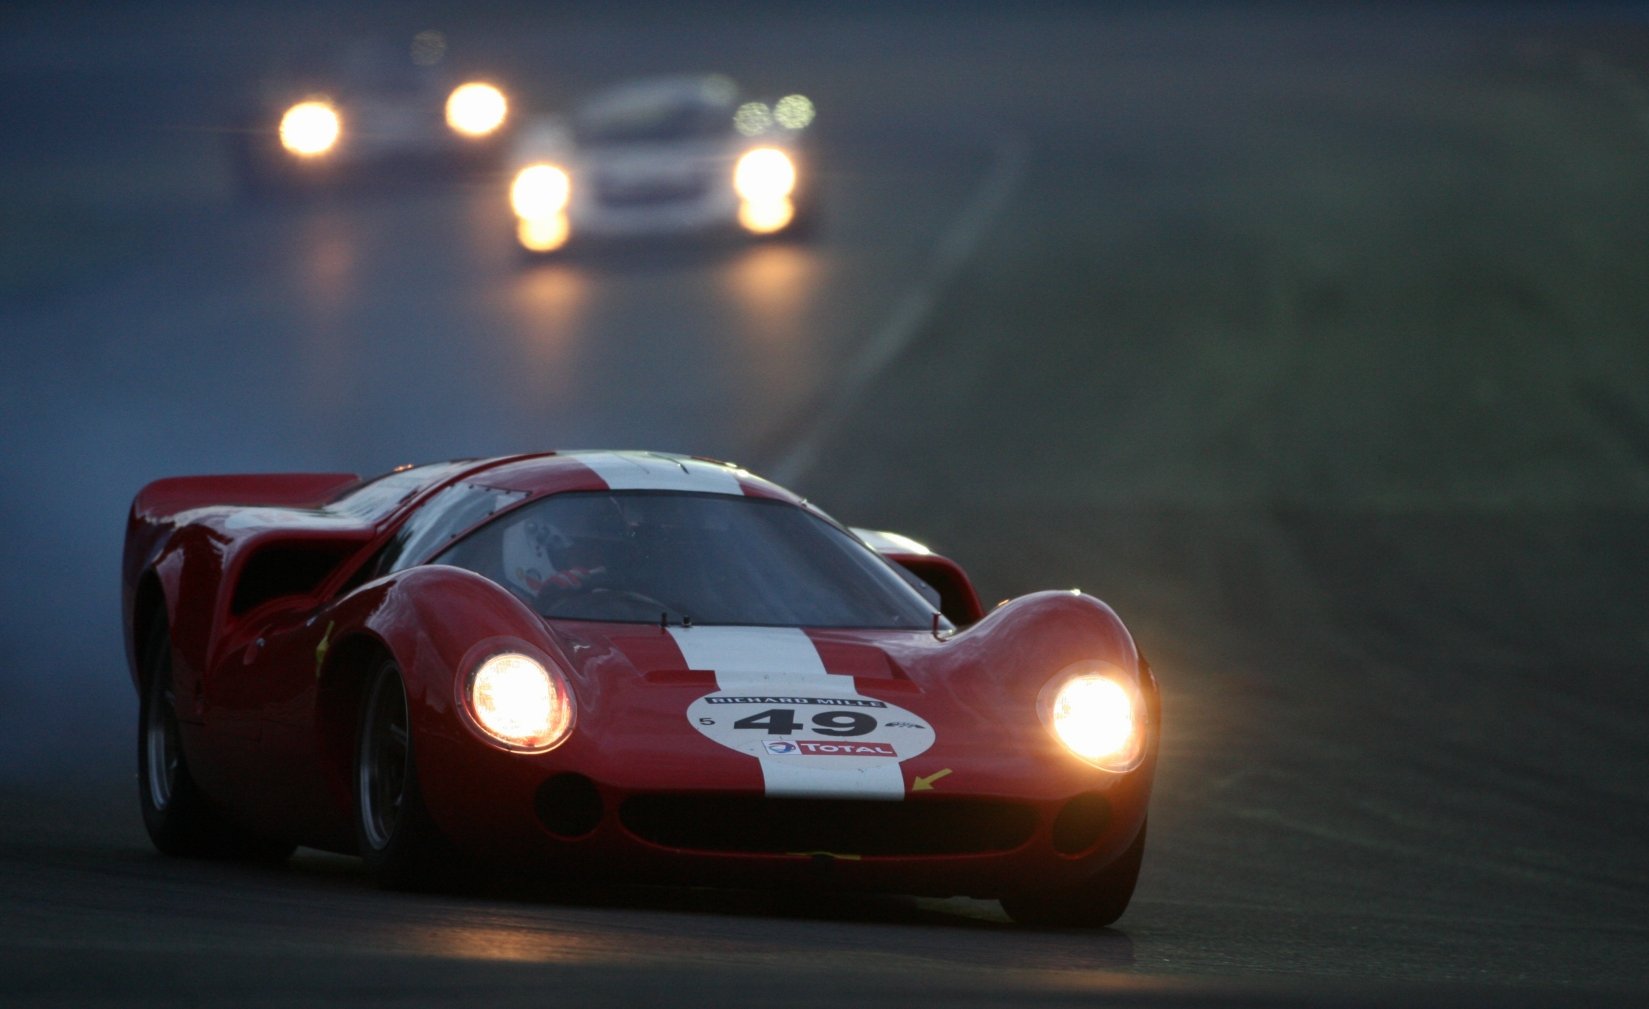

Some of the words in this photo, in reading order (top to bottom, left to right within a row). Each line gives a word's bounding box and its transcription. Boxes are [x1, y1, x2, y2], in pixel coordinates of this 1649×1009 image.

[817, 698, 884, 708] MILLE
[699, 717, 715, 726] 5
[733, 708, 878, 737] 49
[800, 743, 893, 755] TOTAL
